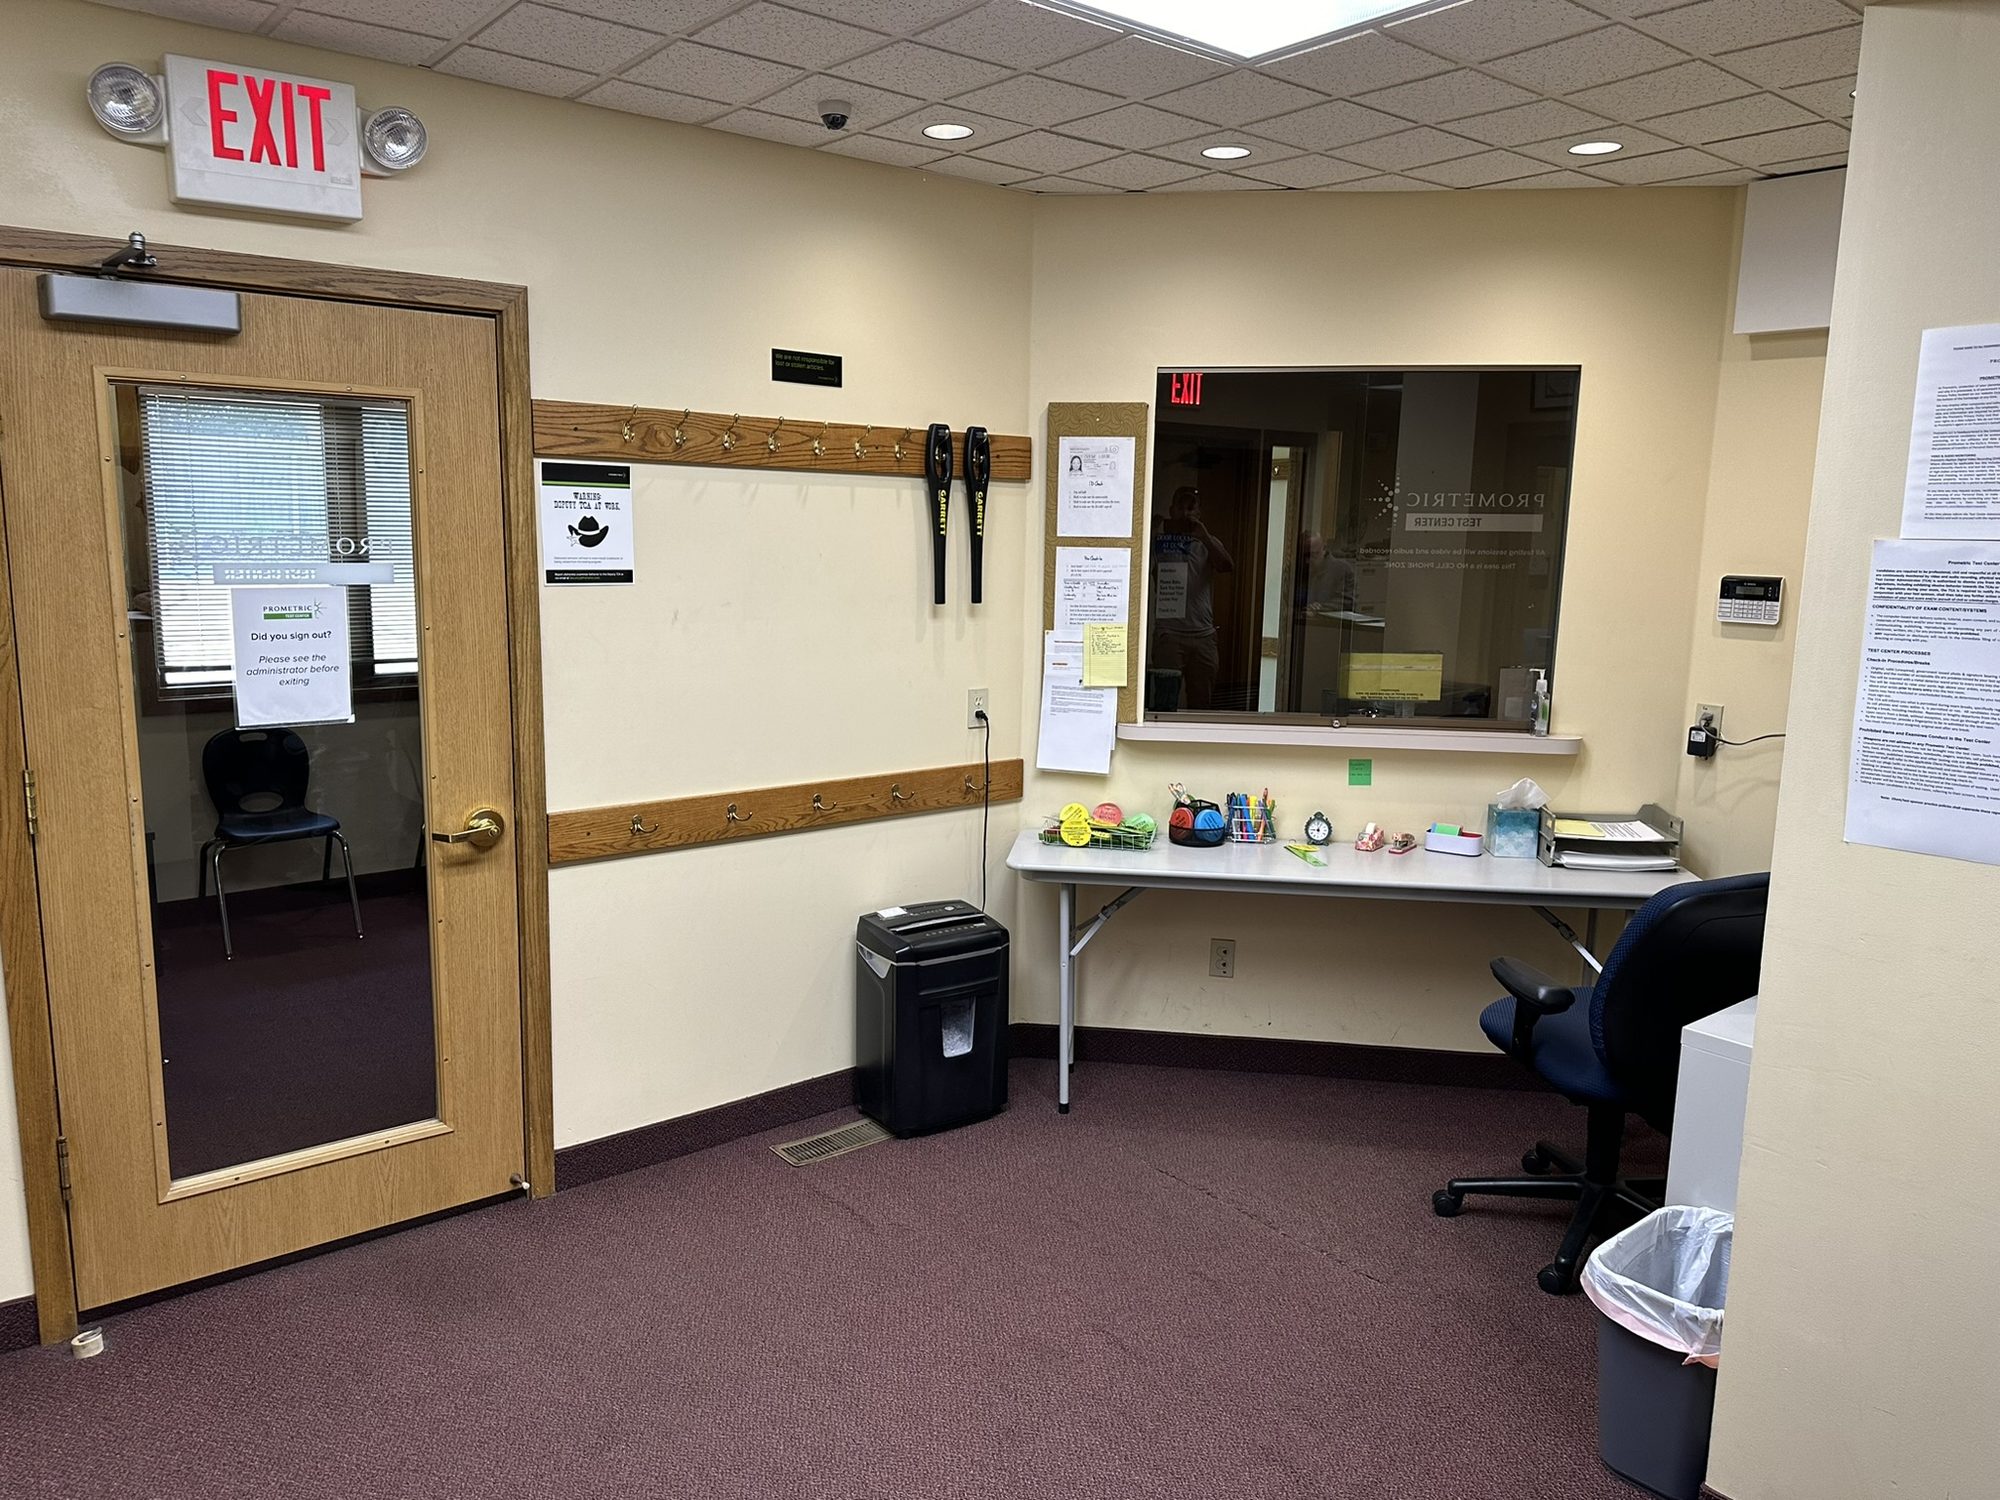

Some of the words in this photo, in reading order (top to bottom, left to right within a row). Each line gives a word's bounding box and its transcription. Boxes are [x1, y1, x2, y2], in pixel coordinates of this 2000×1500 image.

[206, 69, 331, 172] EXIT
[1172, 374, 1203, 405] EXIT
[251, 632, 268, 641] Did
[270, 633, 288, 642] you
[290, 632, 310, 641] sign
[312, 630, 332, 639] out?
[258, 655, 290, 663] Please
[246, 666, 308, 676] administrator
[310, 664, 340, 673] before
[279, 678, 310, 686] exiting
